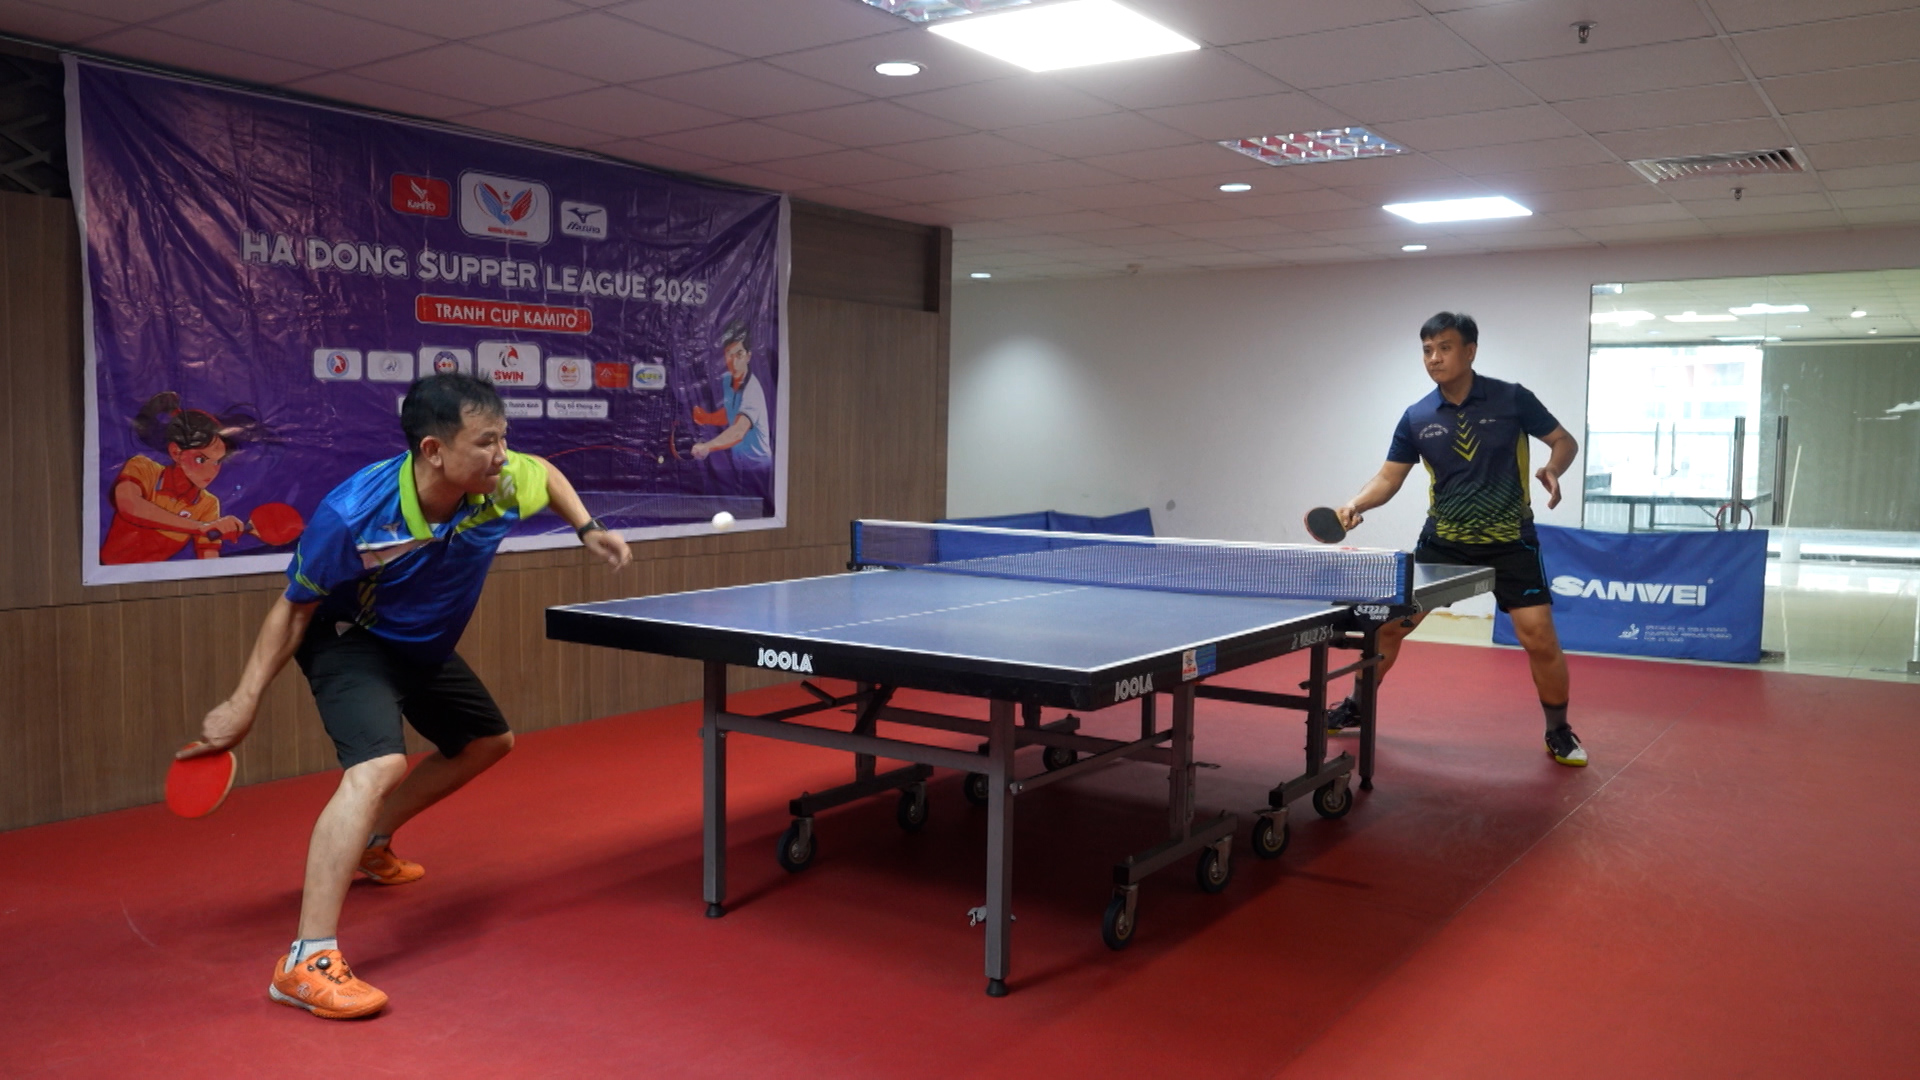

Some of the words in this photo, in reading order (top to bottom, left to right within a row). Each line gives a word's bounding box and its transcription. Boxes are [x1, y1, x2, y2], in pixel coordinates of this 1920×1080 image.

[242, 231, 296, 267] HA
[308, 238, 408, 278] DONG
[418, 249, 538, 289] SUPPER
[546, 265, 647, 299] LEAGUE
[654, 277, 708, 305] 2025
[435, 302, 486, 322] TRANH
[490, 307, 519, 324] CUP
[524, 310, 578, 329] KAMITO
[494, 371, 524, 381] SWIN
[1550, 575, 1707, 606] SANWEI
[757, 647, 814, 674] JOOLA
[1114, 673, 1154, 702] JOOLA
